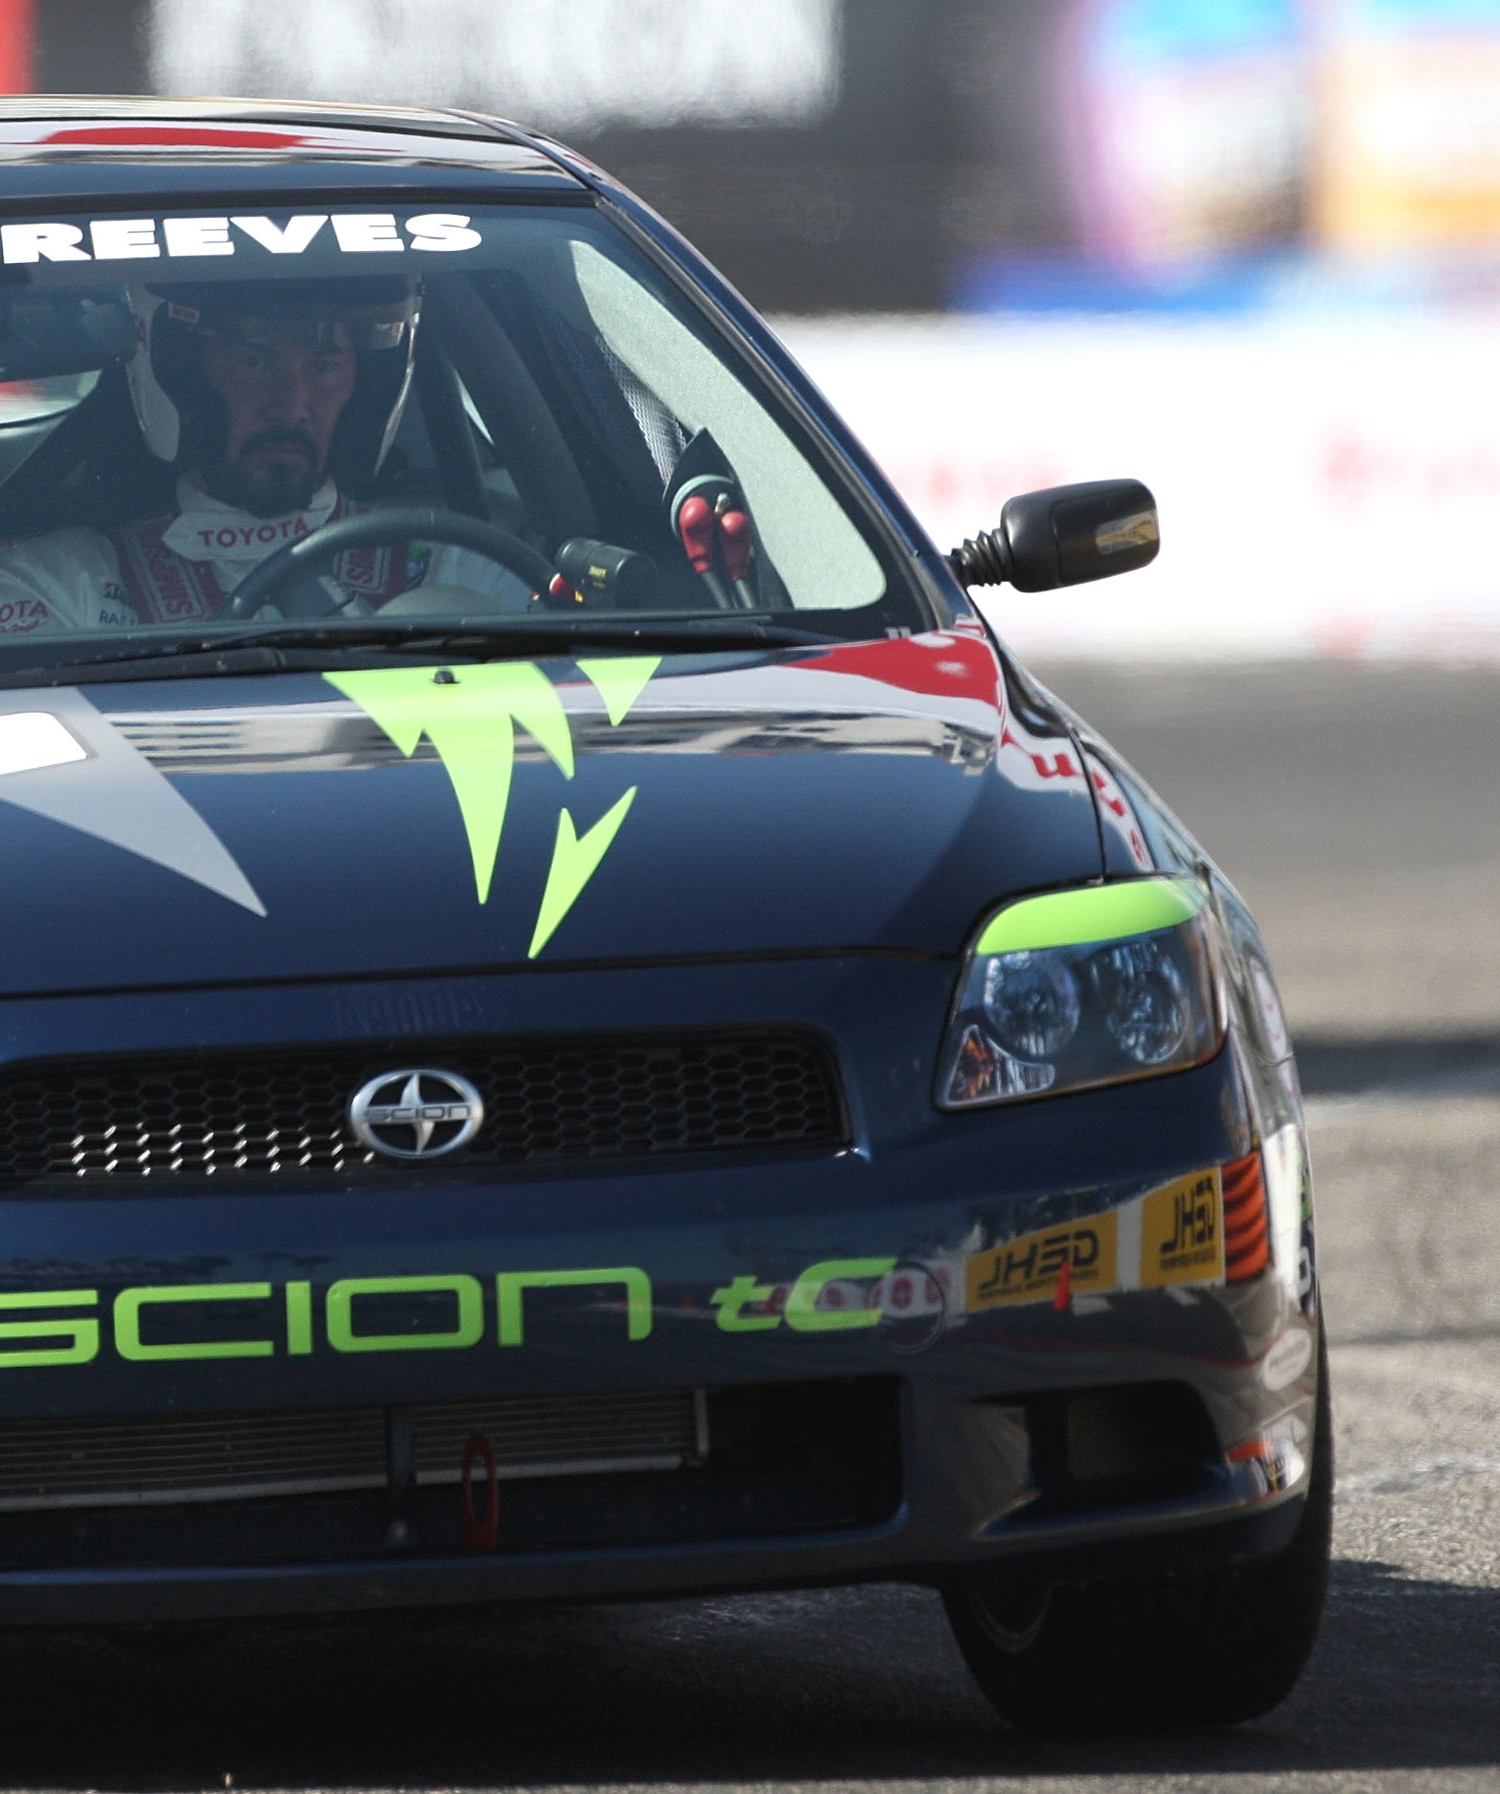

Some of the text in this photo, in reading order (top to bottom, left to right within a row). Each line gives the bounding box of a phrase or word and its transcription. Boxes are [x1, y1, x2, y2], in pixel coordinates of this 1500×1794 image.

[1, 214, 482, 264] REEVES
[197, 517, 312, 548] TOYOTA
[364, 1104, 471, 1121] SCION
[710, 1257, 898, 1332] tC
